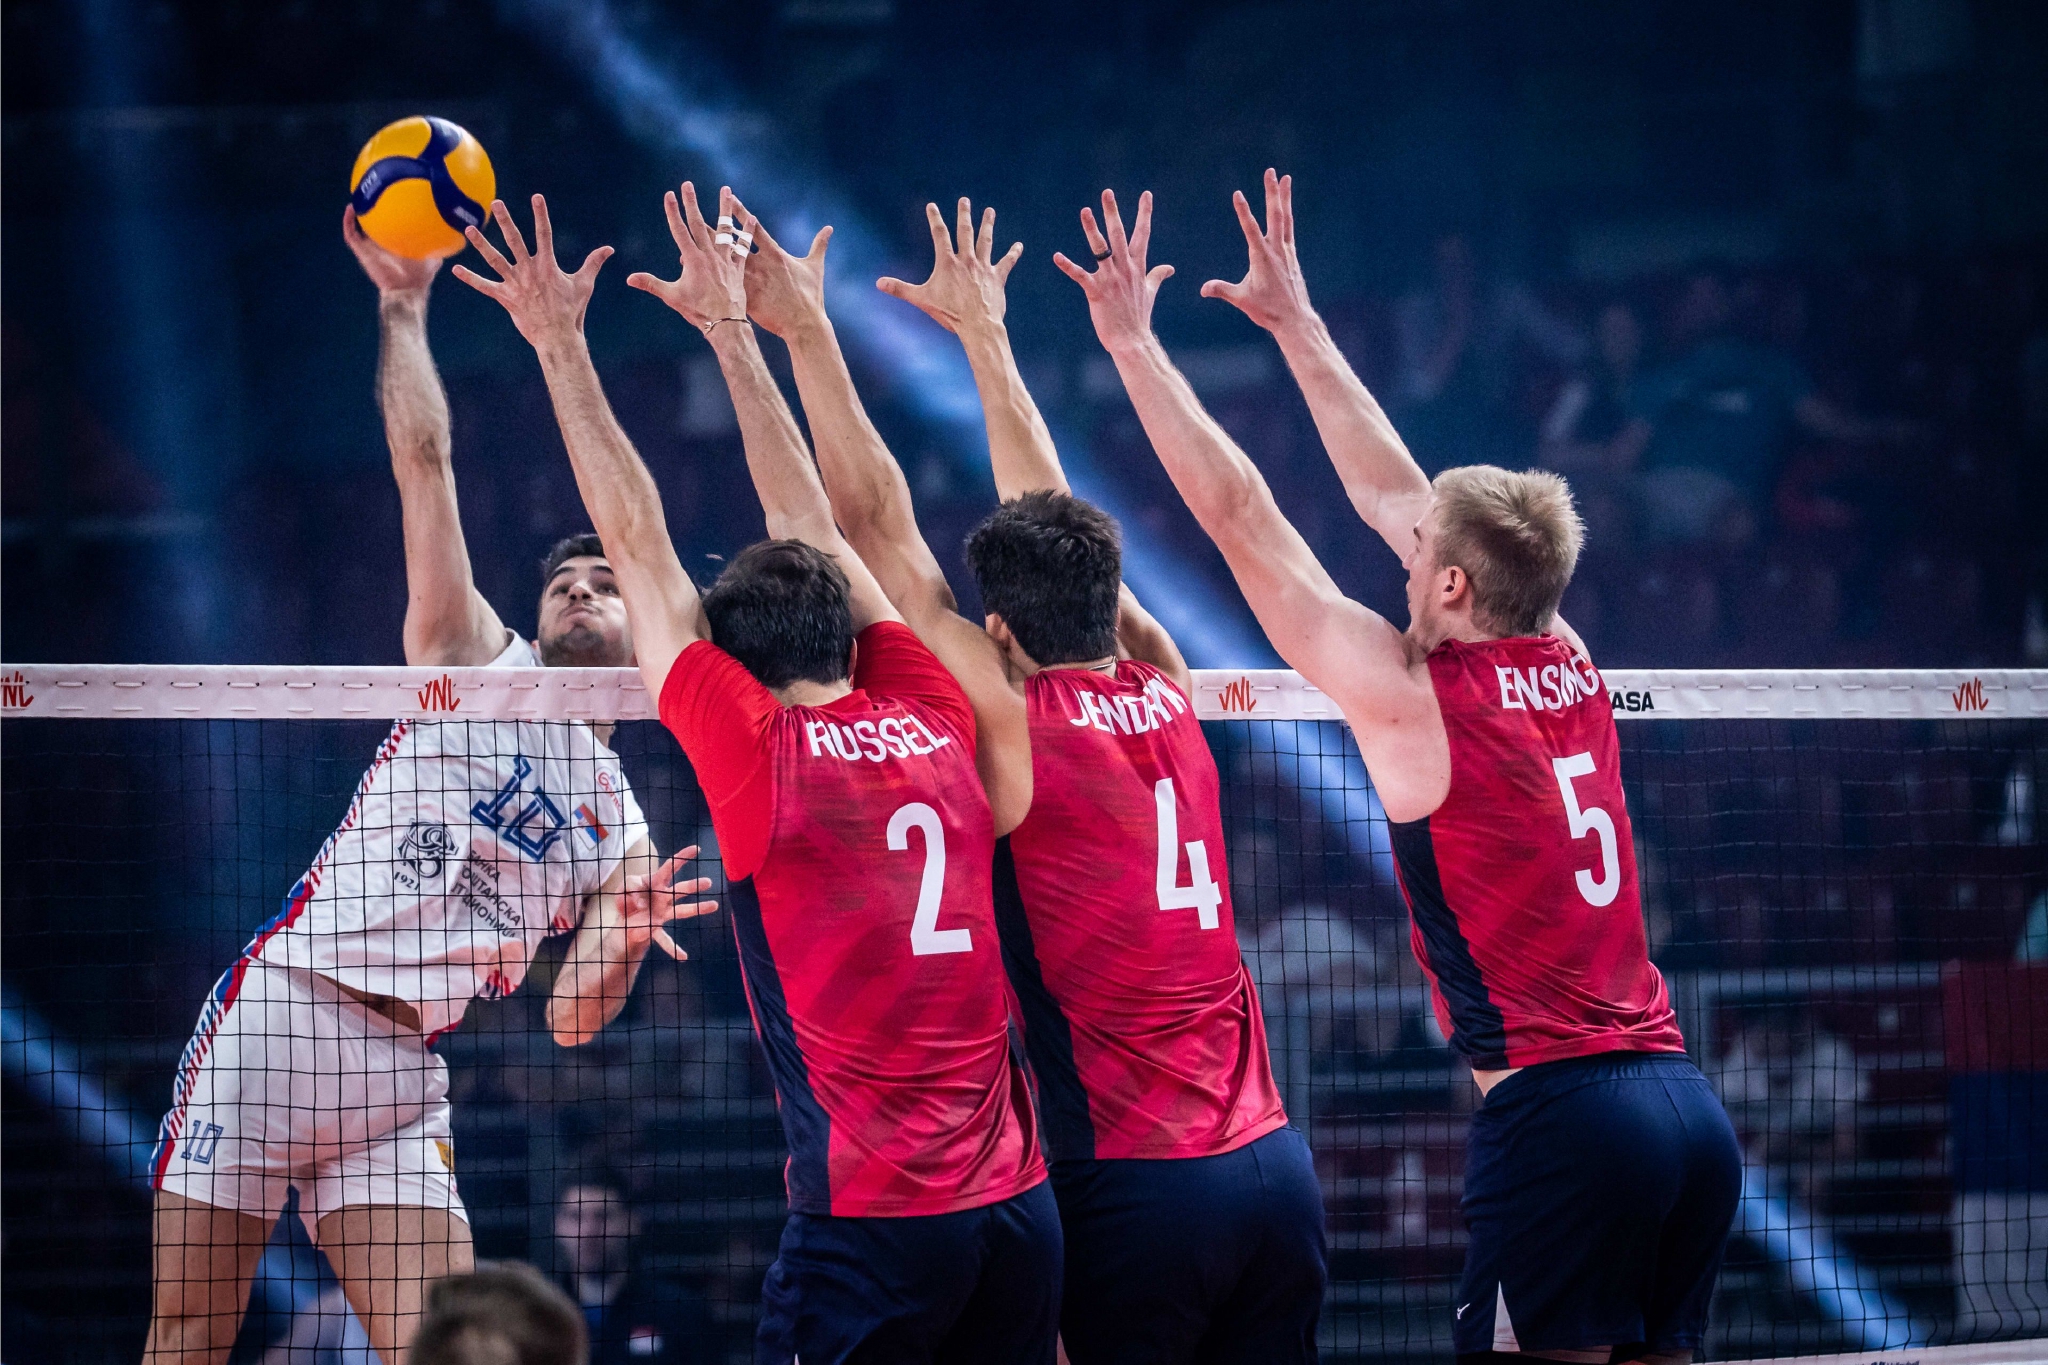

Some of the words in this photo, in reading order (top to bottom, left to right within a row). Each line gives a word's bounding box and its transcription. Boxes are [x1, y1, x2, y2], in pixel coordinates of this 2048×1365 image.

[1, 671, 35, 707] NL
[418, 673, 461, 712] VNL
[1218, 676, 1257, 713] VNL
[1608, 691, 1655, 712] ASA
[1952, 676, 1989, 712] VNL
[470, 754, 567, 863] 10
[1552, 751, 1621, 907] 5
[1154, 777, 1223, 930] 4
[461, 865, 522, 926] ОШТАНСКА
[886, 802, 974, 956] 2
[180, 1119, 225, 1165] 10
